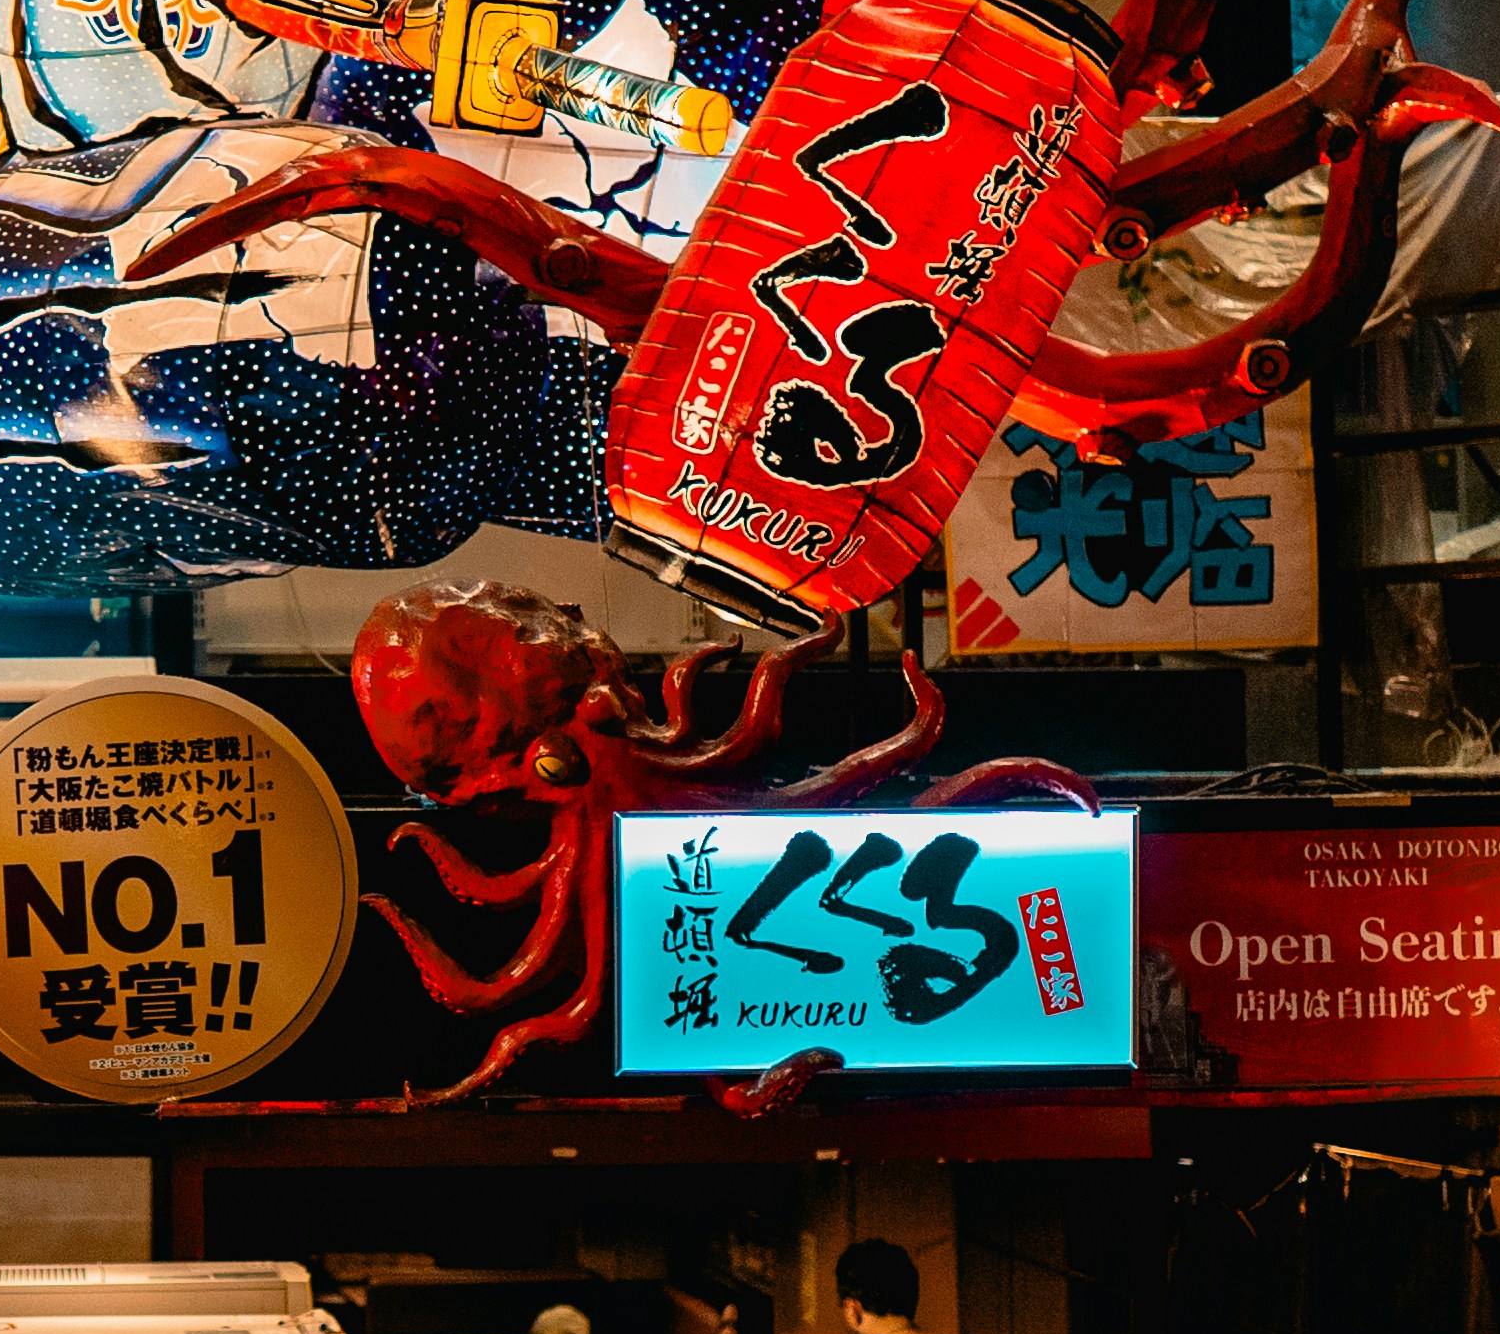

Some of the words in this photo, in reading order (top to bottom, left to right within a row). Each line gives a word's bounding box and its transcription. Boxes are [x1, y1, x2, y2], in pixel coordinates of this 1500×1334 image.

[749, 79, 953, 491] くくる
[674, 312, 755, 454] たこ家
[665, 459, 864, 571] KUKURU
[2, 829, 267, 960] NO.1
[1304, 841, 1383, 863] OSAKA
[1304, 867, 1430, 889] TAKOYAKI
[662, 825, 723, 1036] 道頓堀
[723, 829, 1021, 1026] くくる
[1019, 889, 1084, 1014] たこ家
[1189, 919, 1336, 982] Open
[736, 1000, 868, 1029] KUKURU
